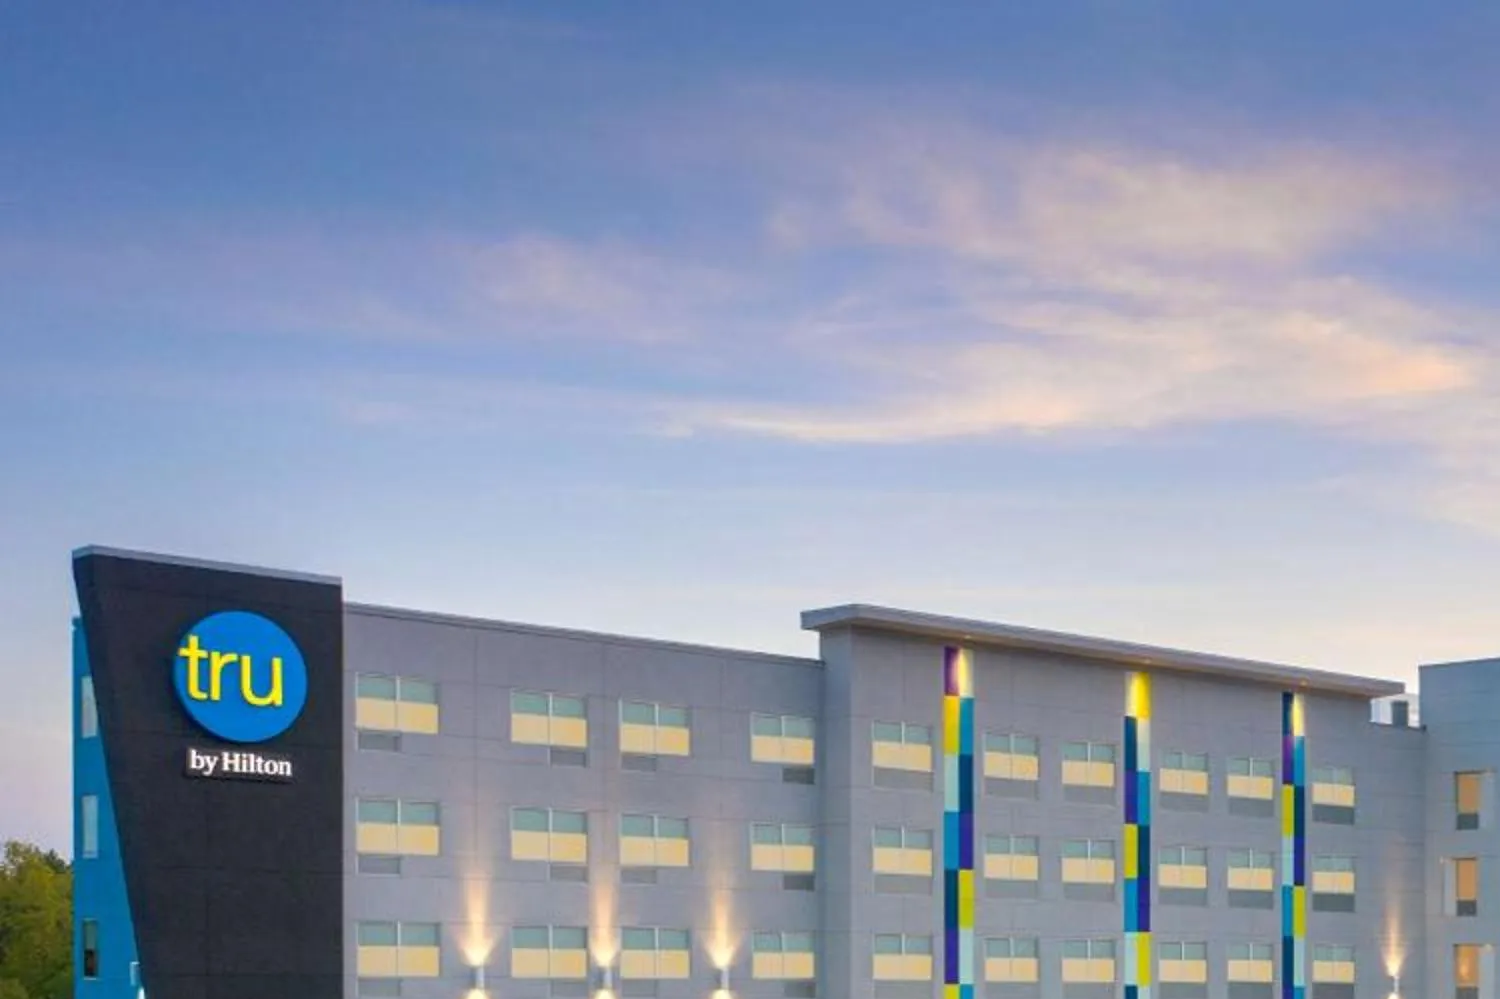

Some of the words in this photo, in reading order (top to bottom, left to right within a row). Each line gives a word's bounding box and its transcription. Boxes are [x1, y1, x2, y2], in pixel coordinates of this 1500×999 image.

[178, 633, 283, 707] tru
[189, 749, 219, 776] by
[221, 752, 293, 776] Hilton
